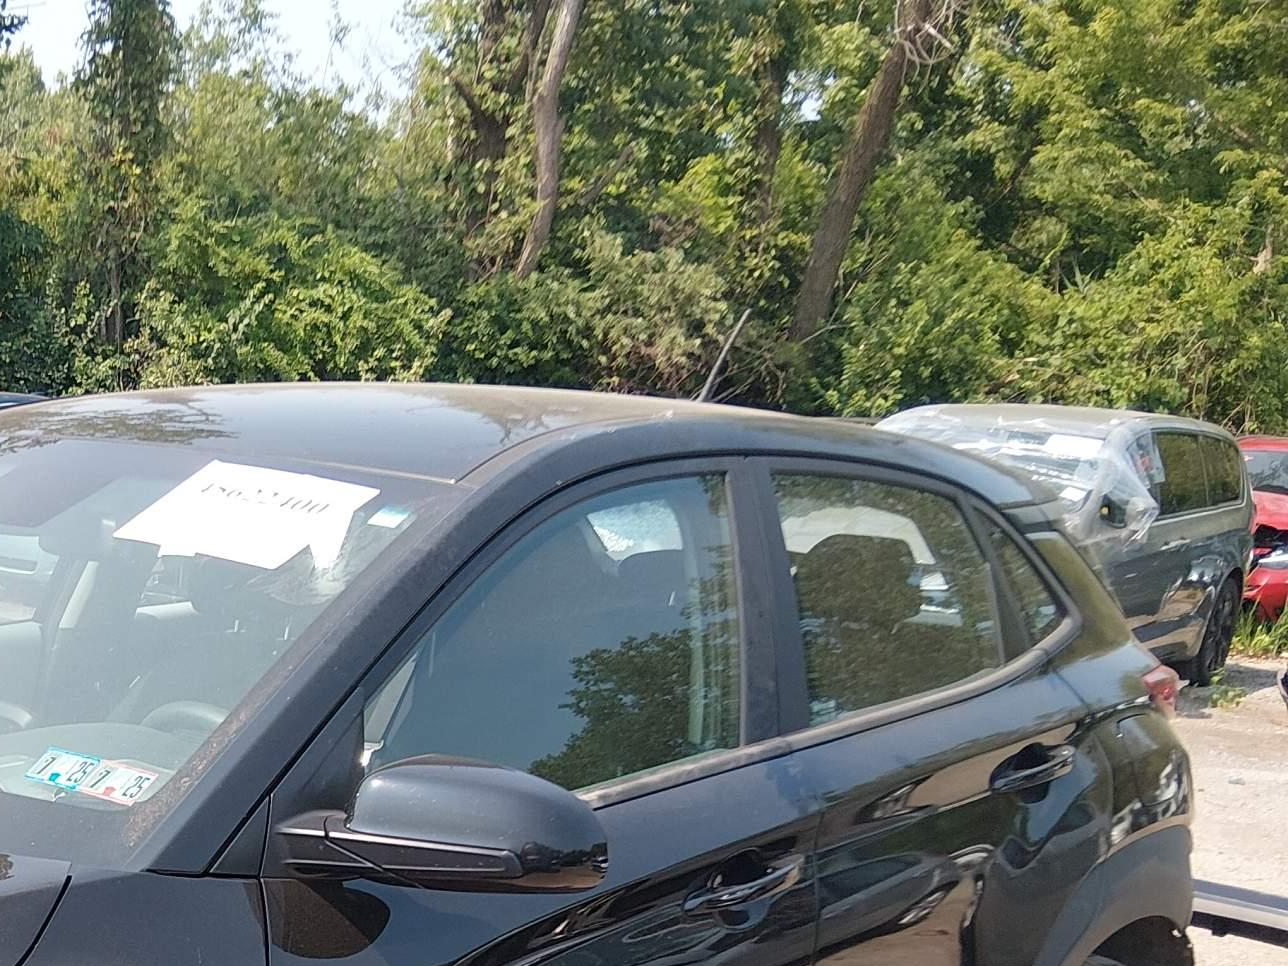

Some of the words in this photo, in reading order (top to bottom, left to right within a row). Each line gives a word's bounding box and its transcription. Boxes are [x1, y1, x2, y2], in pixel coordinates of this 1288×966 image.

[37, 756, 56, 775] 7
[67, 761, 95, 784] 25
[90, 768, 111, 789] 7
[123, 775, 151, 799] 25
